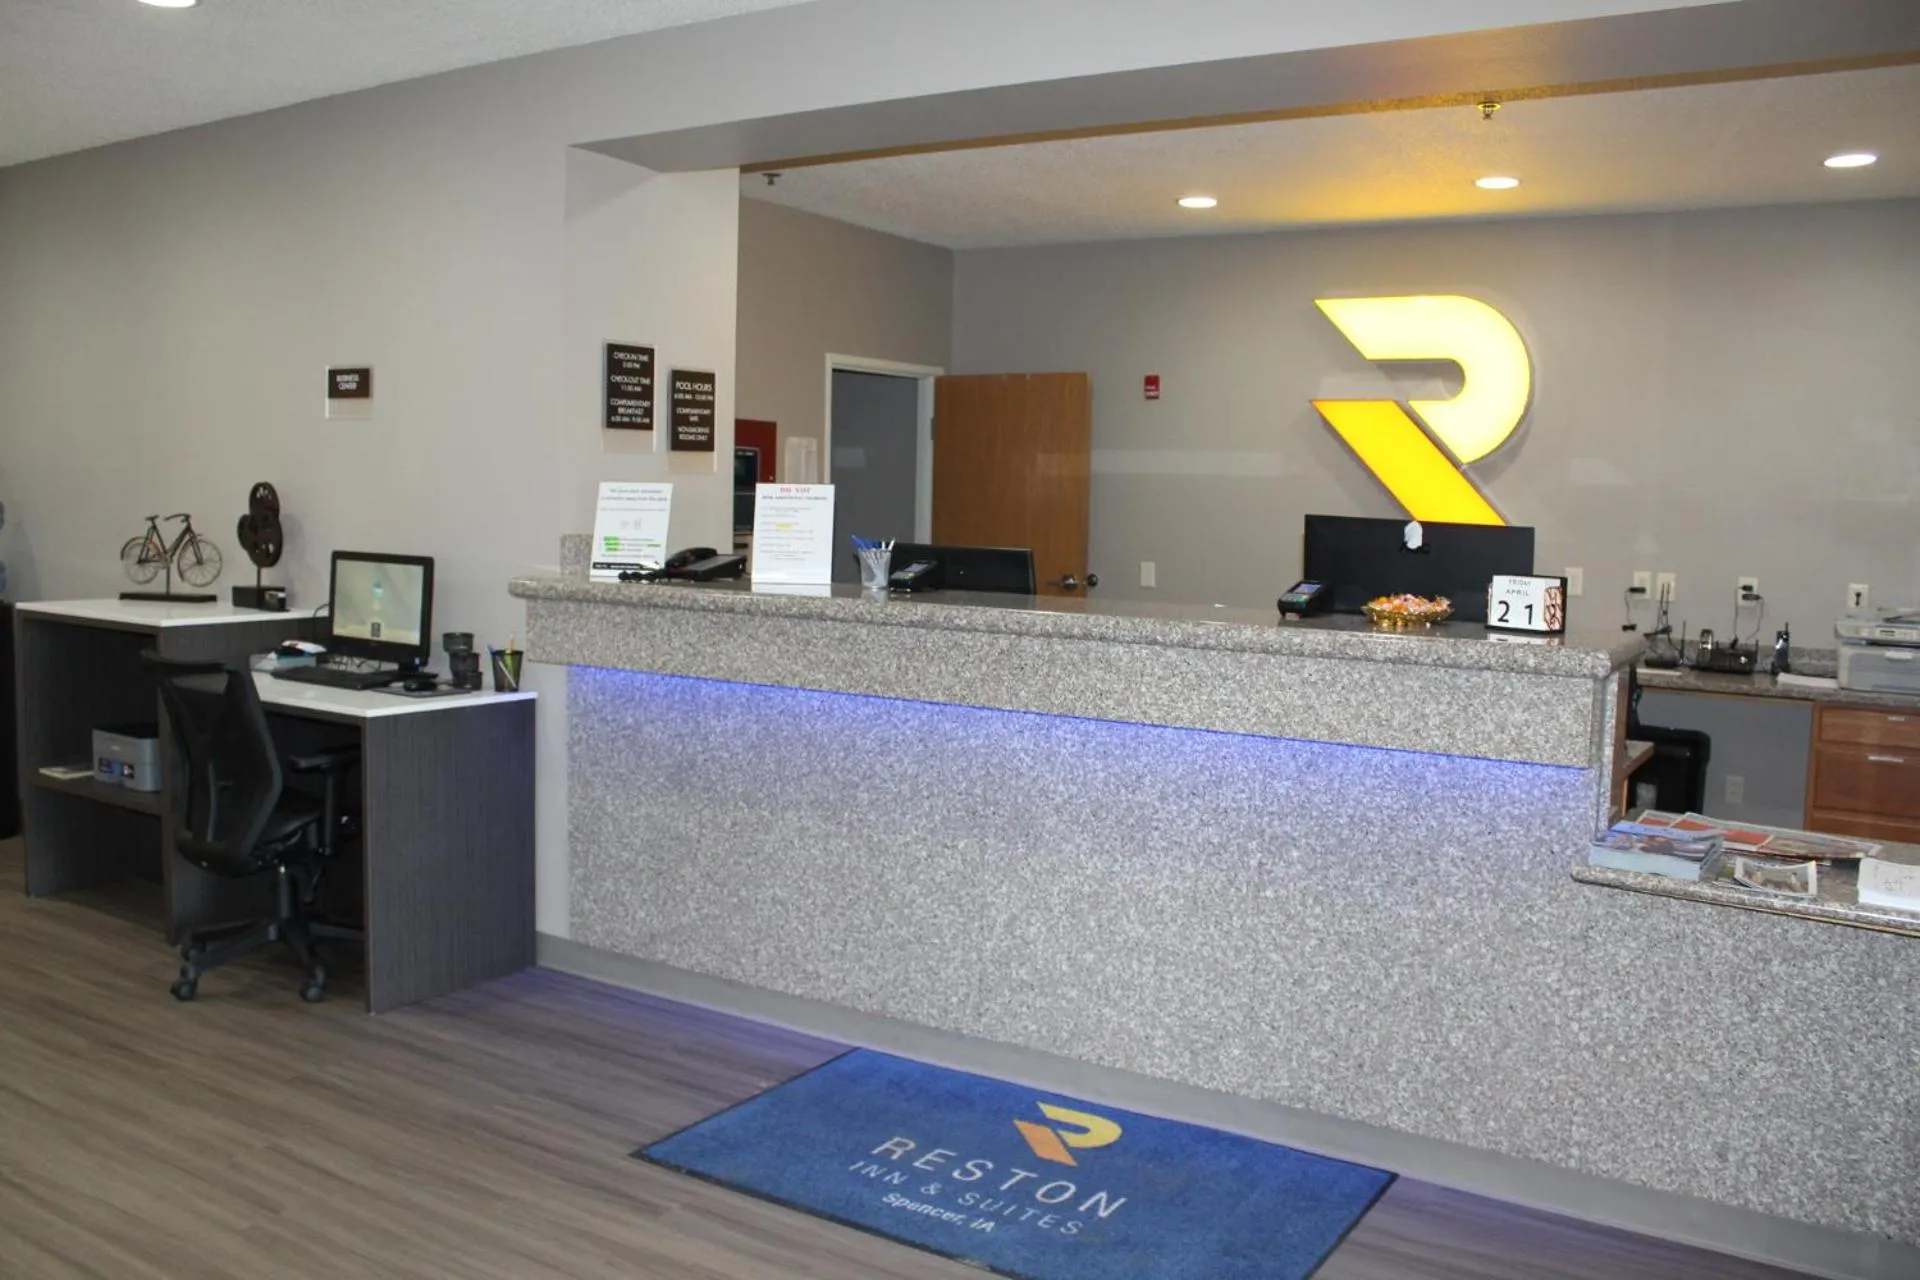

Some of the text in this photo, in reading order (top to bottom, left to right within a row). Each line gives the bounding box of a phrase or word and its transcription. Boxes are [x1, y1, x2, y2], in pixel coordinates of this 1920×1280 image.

[676, 381, 713, 392] POOL HOURS
[1308, 294, 1531, 527] R
[1508, 578, 1531, 587] FRIDAY
[1505, 588, 1529, 597] APRIL
[871, 1136, 1127, 1219] RESTON
[849, 1161, 1084, 1236] INN & SUITES
[969, 1217, 997, 1233] IA
